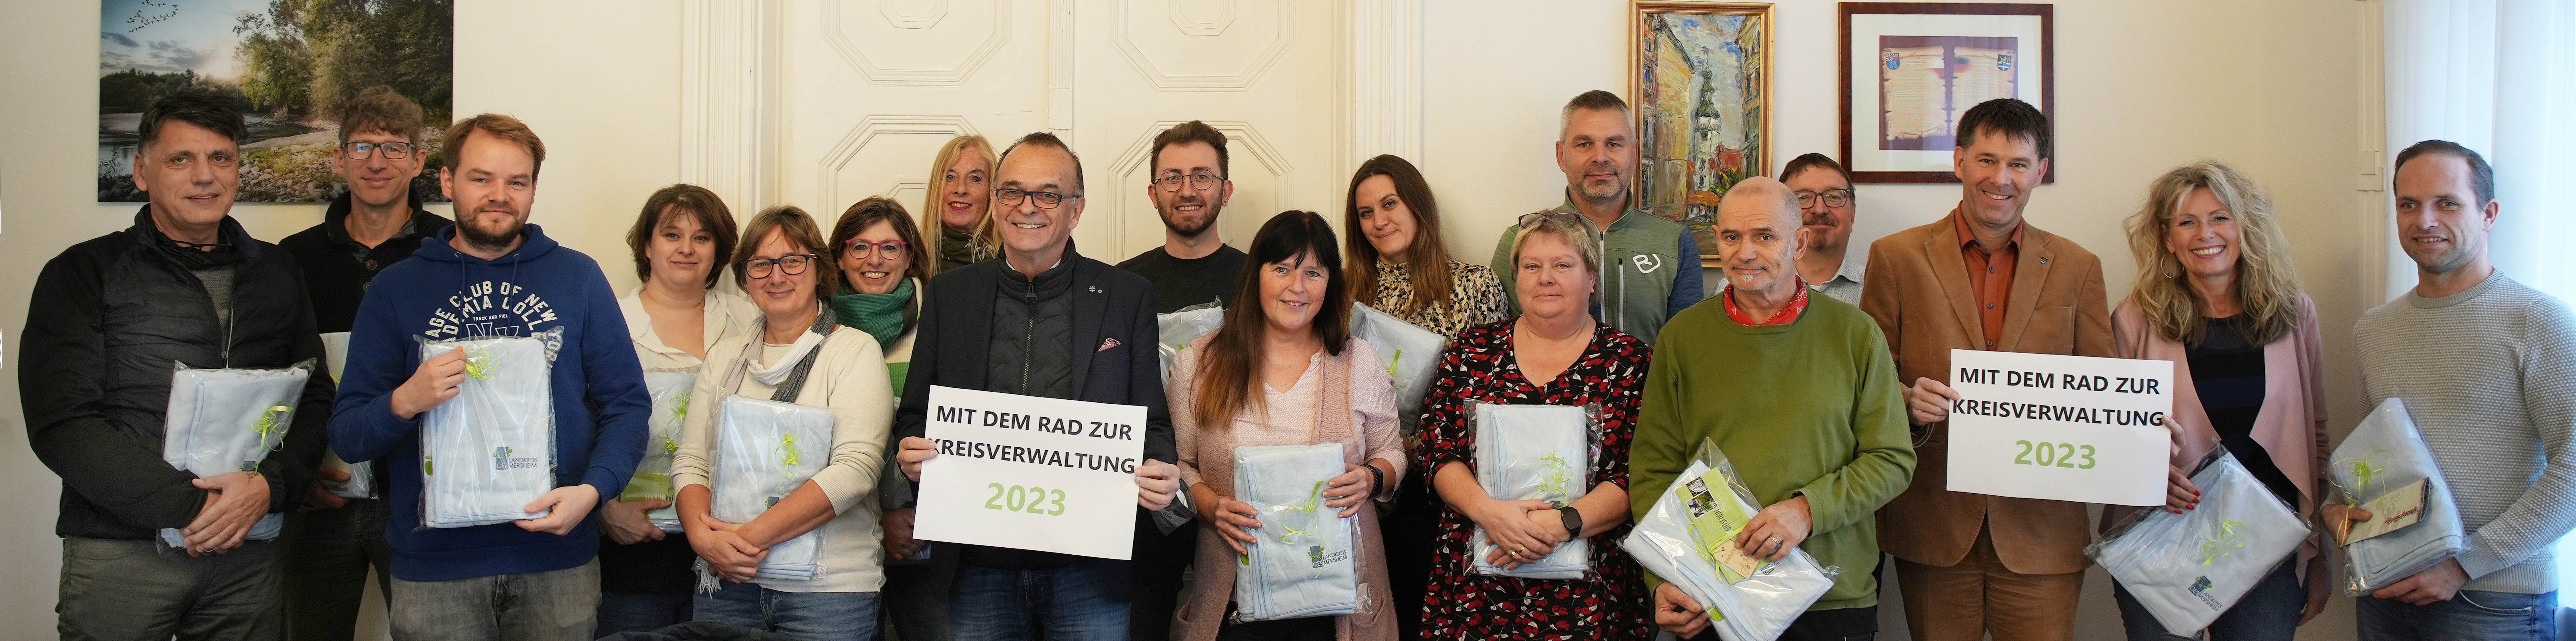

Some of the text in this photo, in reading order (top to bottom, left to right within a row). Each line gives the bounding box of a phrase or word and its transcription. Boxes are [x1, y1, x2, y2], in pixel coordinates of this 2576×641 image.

[449, 281, 493, 310] CLUB
[500, 281, 522, 296] OF
[524, 293, 558, 322] NEW
[1960, 367, 2160, 395] MIT DEM RAD ZUR
[936, 405, 1133, 441] MIT DEM RAD ZUR
[1953, 399, 2164, 426] KREISVERWALTUNG
[2014, 440, 2096, 470] 2023
[984, 482, 1066, 516] 2023
[1313, 555, 1348, 567] GERMERSHEIM
[1323, 550, 1347, 560] LANDKREIS
